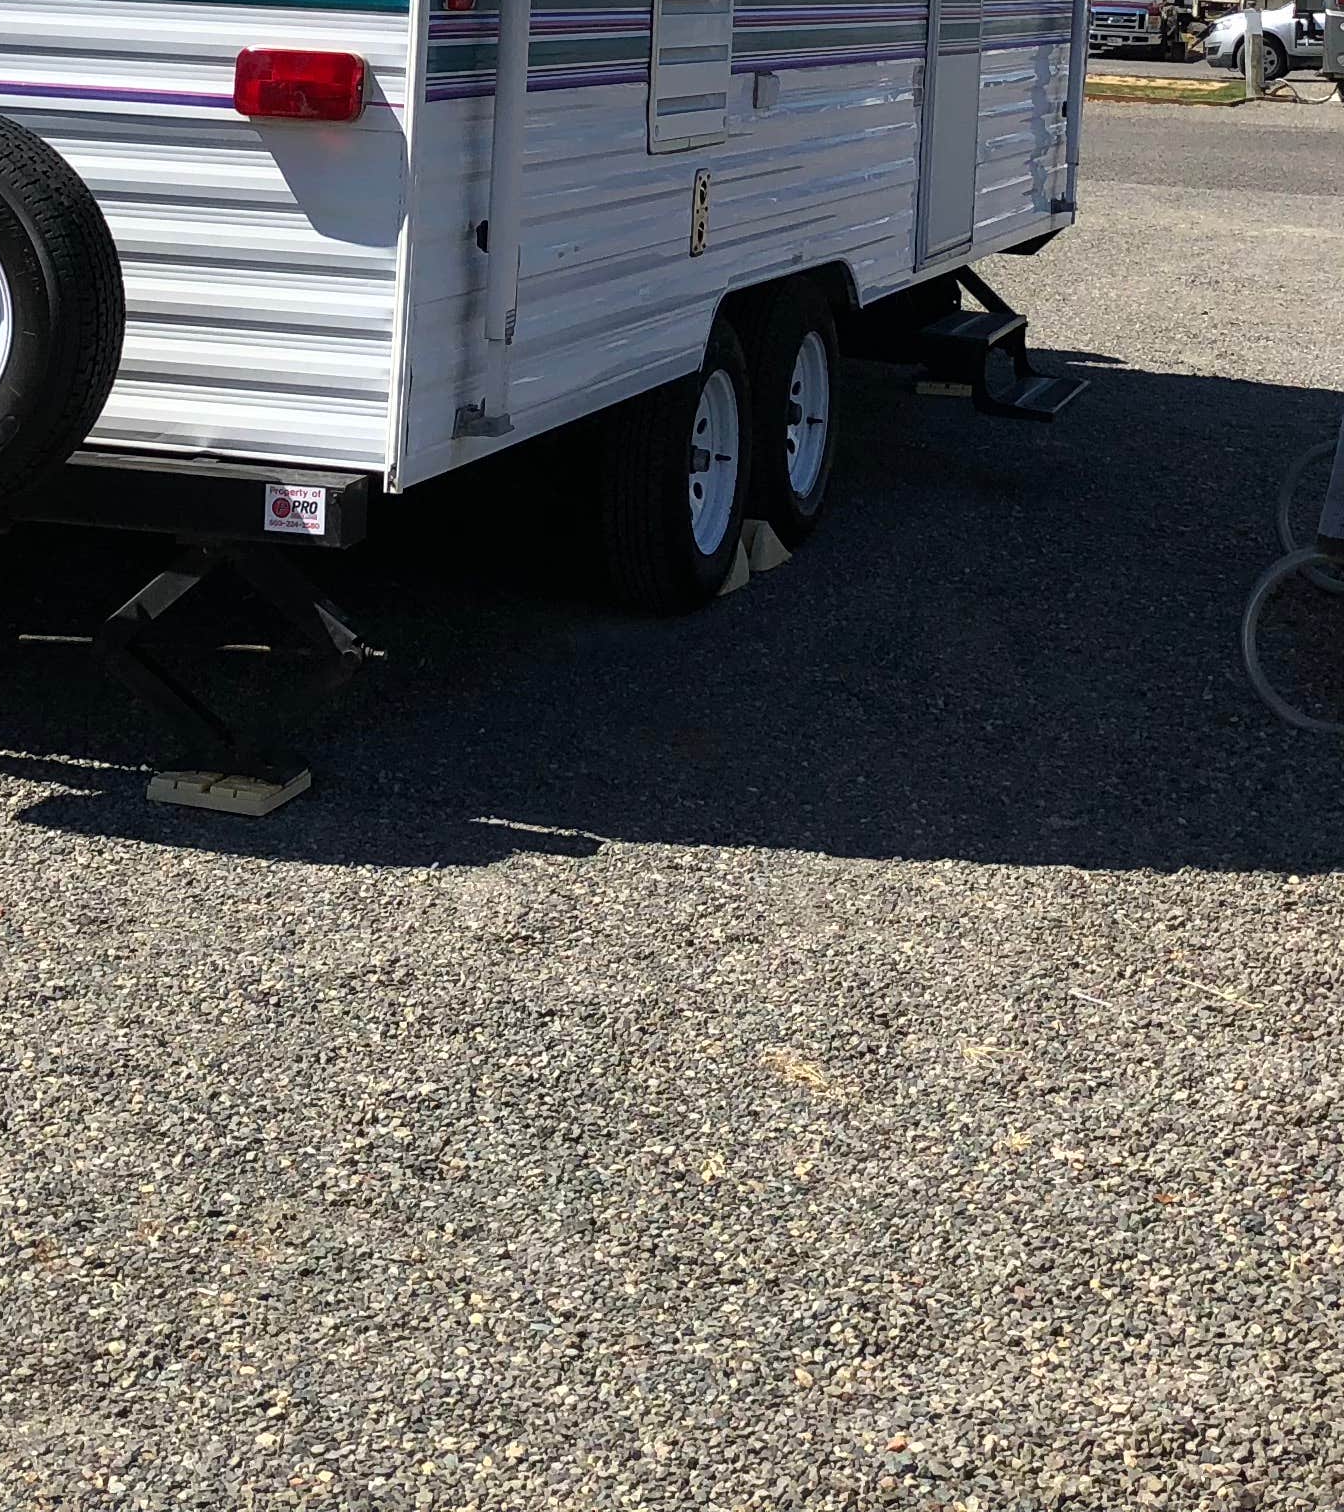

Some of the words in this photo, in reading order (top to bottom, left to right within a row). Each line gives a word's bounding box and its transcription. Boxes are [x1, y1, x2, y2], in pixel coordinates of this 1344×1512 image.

[269, 486, 309, 498] Property
[311, 490, 322, 498] of
[291, 500, 319, 514] PRO
